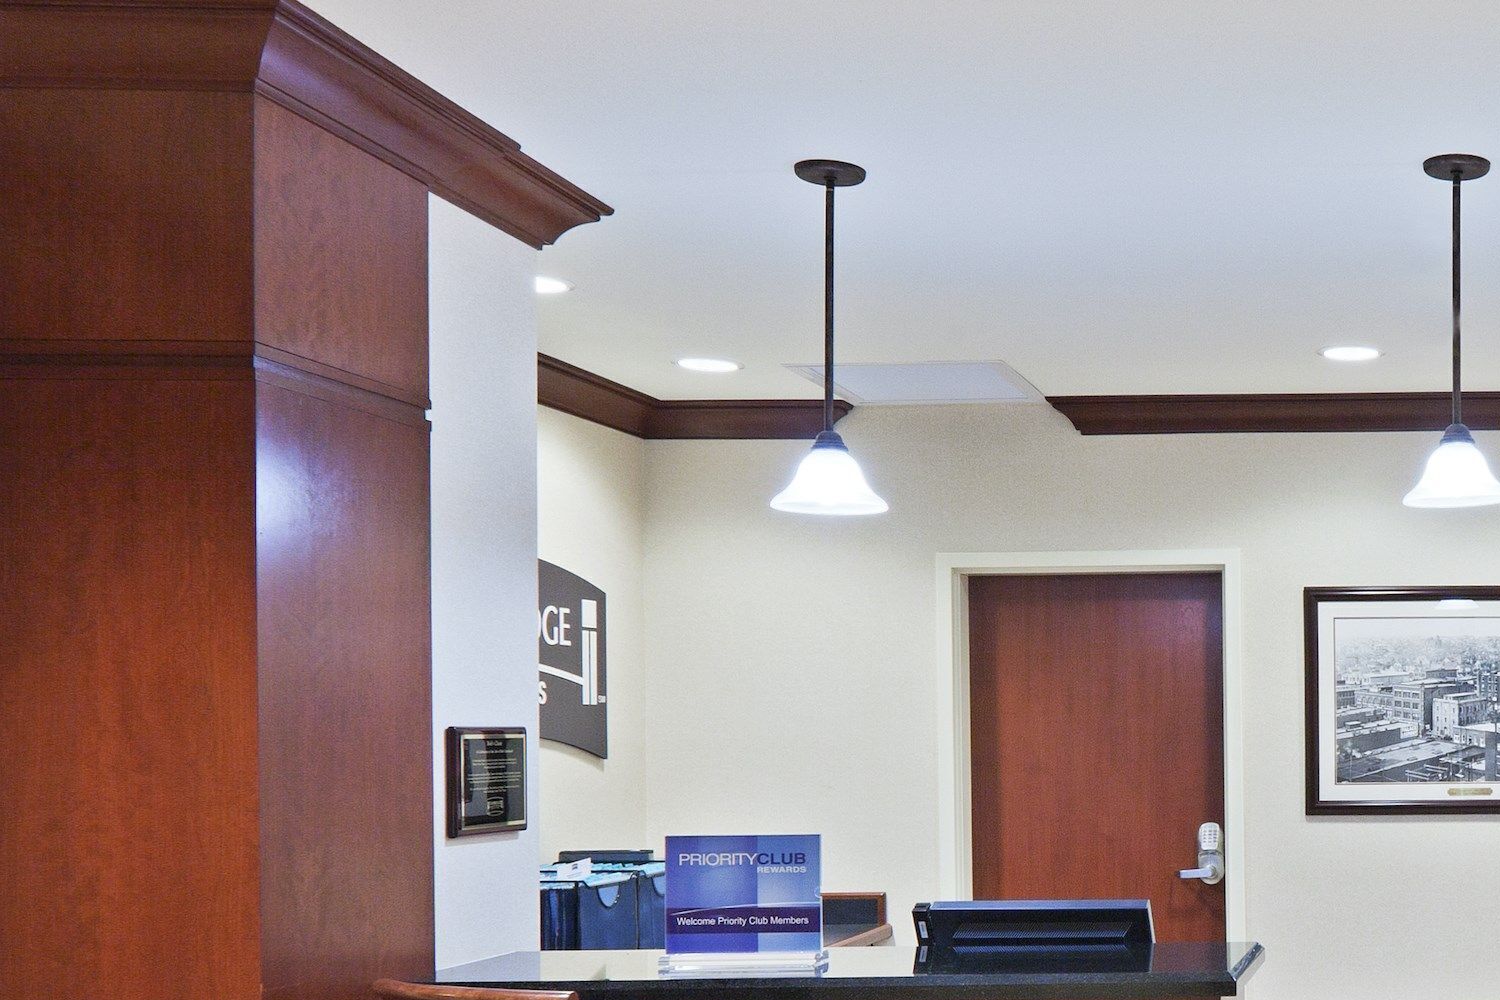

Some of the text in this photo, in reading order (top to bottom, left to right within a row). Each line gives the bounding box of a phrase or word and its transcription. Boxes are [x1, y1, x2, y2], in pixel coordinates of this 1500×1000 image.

[757, 866, 807, 874] REWARDS
[677, 916, 809, 927] Welcome Priority Club Members
